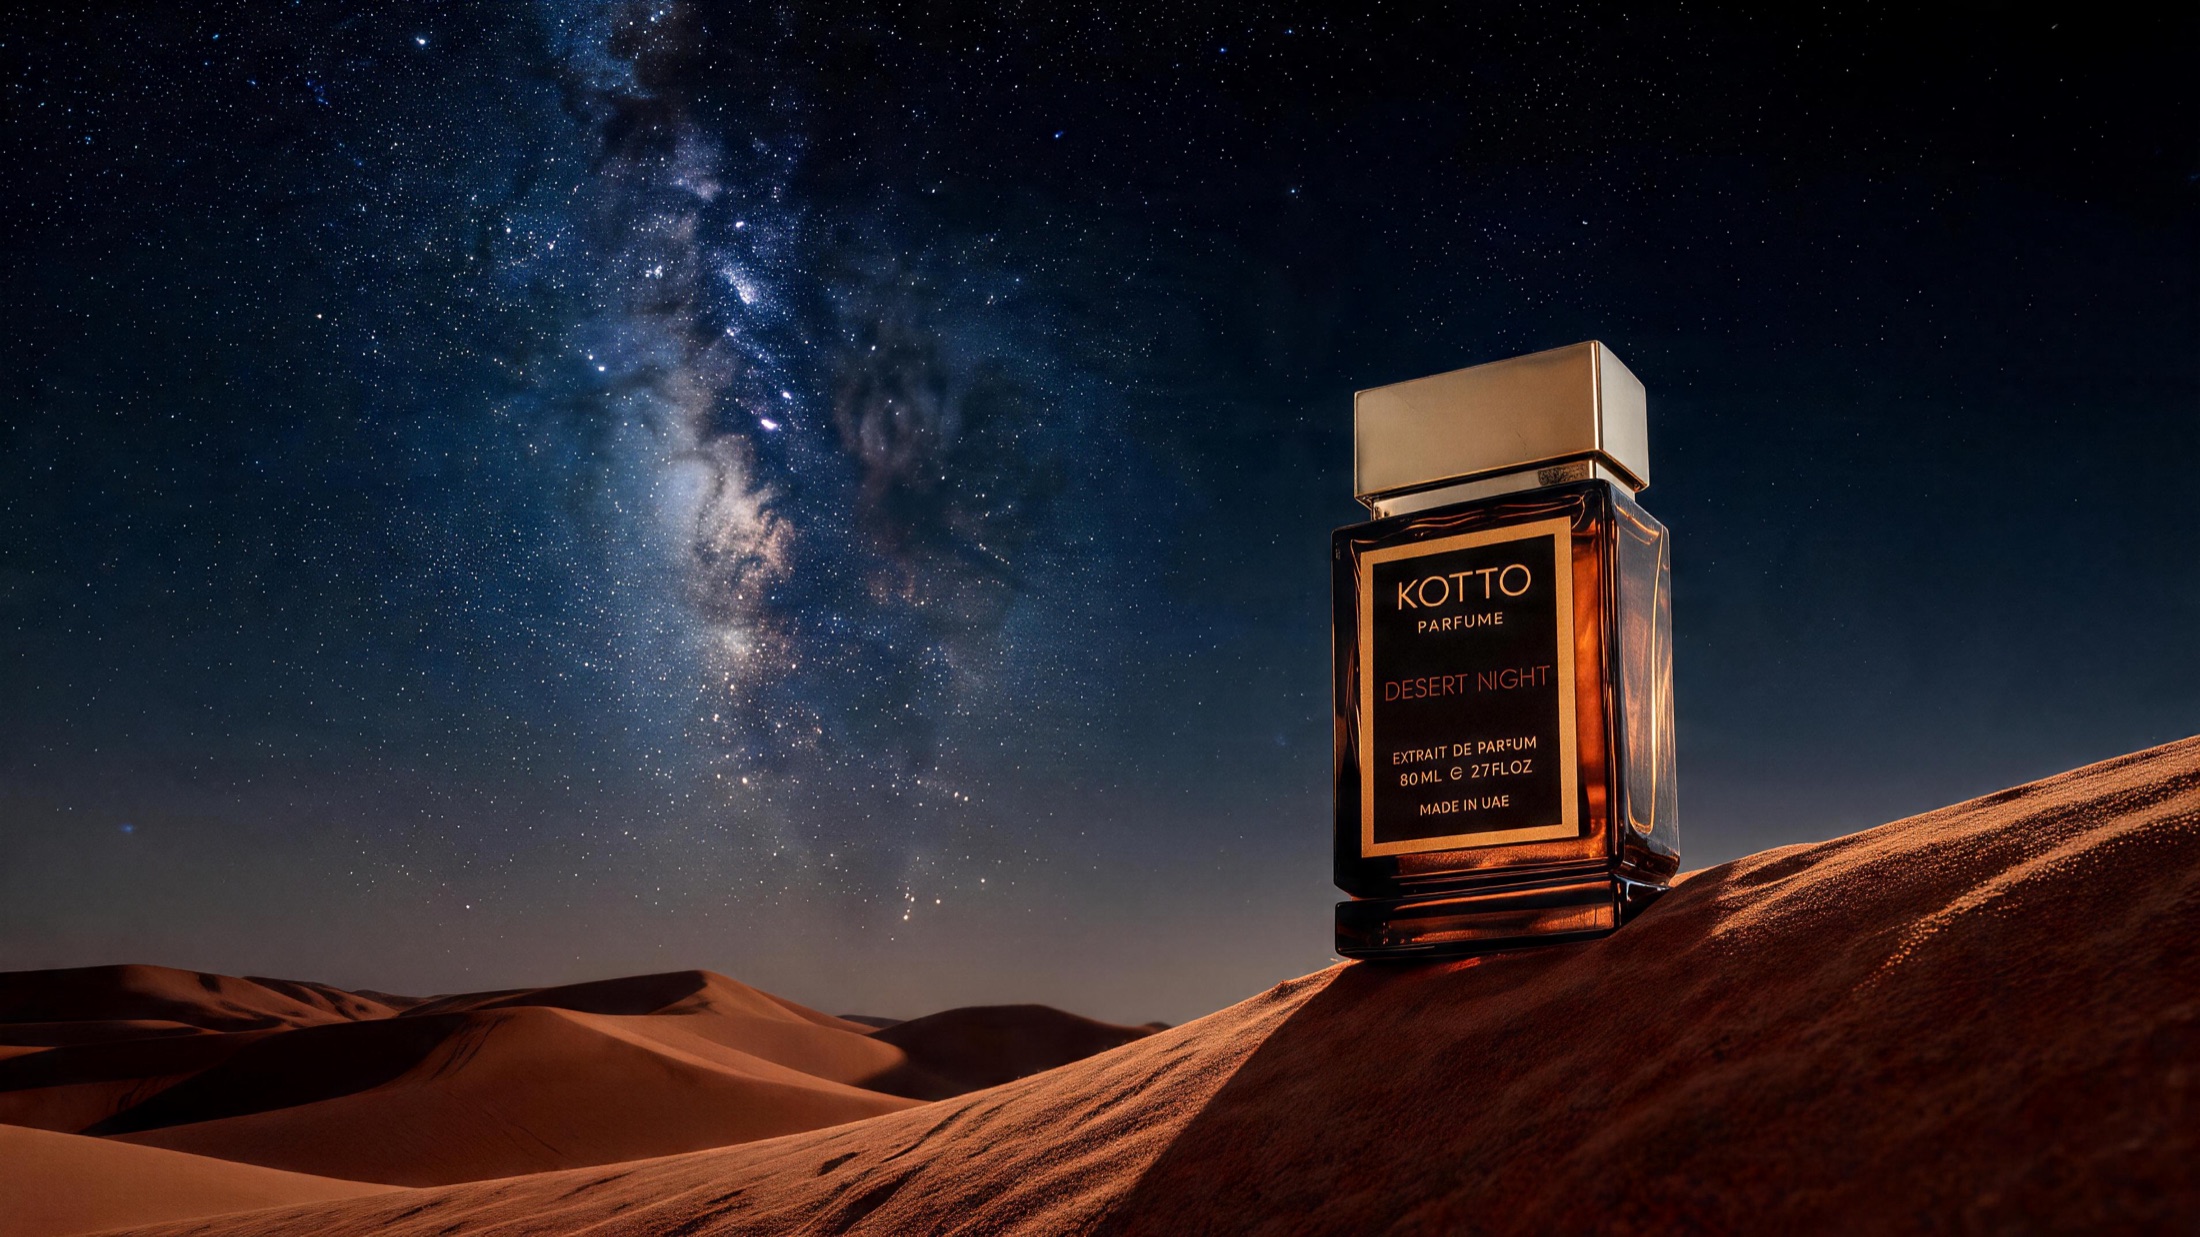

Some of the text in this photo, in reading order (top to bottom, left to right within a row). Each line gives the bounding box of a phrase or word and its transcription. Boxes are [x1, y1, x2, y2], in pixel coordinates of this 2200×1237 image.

[1397, 563, 1531, 611] KOTTO
[1418, 612, 1503, 634] PARFUME
[1385, 665, 1550, 701] DESERT NIGHT
[1393, 745, 1448, 765] EXTRAIT
[1453, 742, 1472, 757] DE
[1420, 795, 1510, 816] MADE IN UAE
